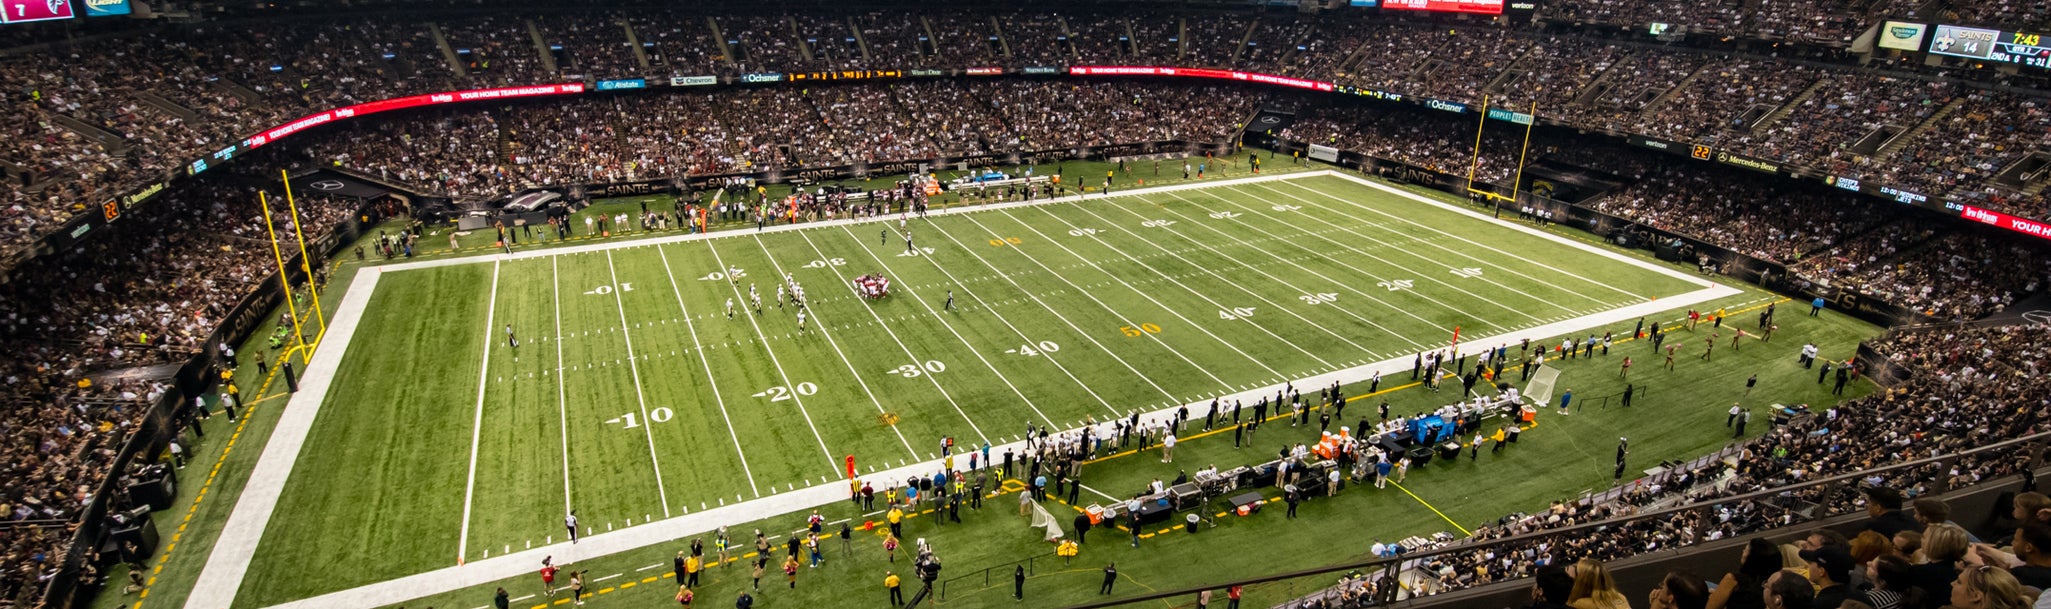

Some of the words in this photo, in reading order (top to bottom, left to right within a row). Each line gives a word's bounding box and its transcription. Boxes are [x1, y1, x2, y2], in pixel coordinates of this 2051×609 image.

[15, 4, 25, 16] 7
[1959, 31, 1992, 42] SAINTS
[2013, 32, 2040, 46] 7:43
[1964, 42, 1977, 53] 14
[2014, 55, 2020, 63] 6
[2035, 58, 2046, 66] 31
[749, 74, 779, 82] Ochsner
[480, 90, 500, 98] HOME
[500, 88, 519, 96] TEAM
[1431, 100, 1462, 113] Ochsner
[1490, 110, 1511, 120] PEOPLES
[1645, 140, 1667, 149] verizon
[1695, 146, 1710, 158] 22
[962, 156, 993, 167] SAINTS
[1729, 155, 1778, 172] Mercedes-Benz
[884, 163, 917, 173] SAINTS
[800, 169, 835, 180] SAINTS
[607, 183, 649, 196] SAINTS
[104, 201, 118, 219] 22
[2012, 219, 2041, 234] YOUR
[2041, 227, 2051, 237] H
[810, 257, 847, 269] 30
[1450, 267, 1482, 278] 10
[595, 281, 634, 295] 10
[1378, 279, 1412, 291] 20
[1300, 292, 1337, 305] 30
[1219, 307, 1253, 321] 40
[1120, 322, 1162, 338] 50
[1018, 340, 1060, 357] 40
[899, 360, 946, 379] 30
[765, 381, 818, 403] 20
[622, 406, 674, 430] 10
